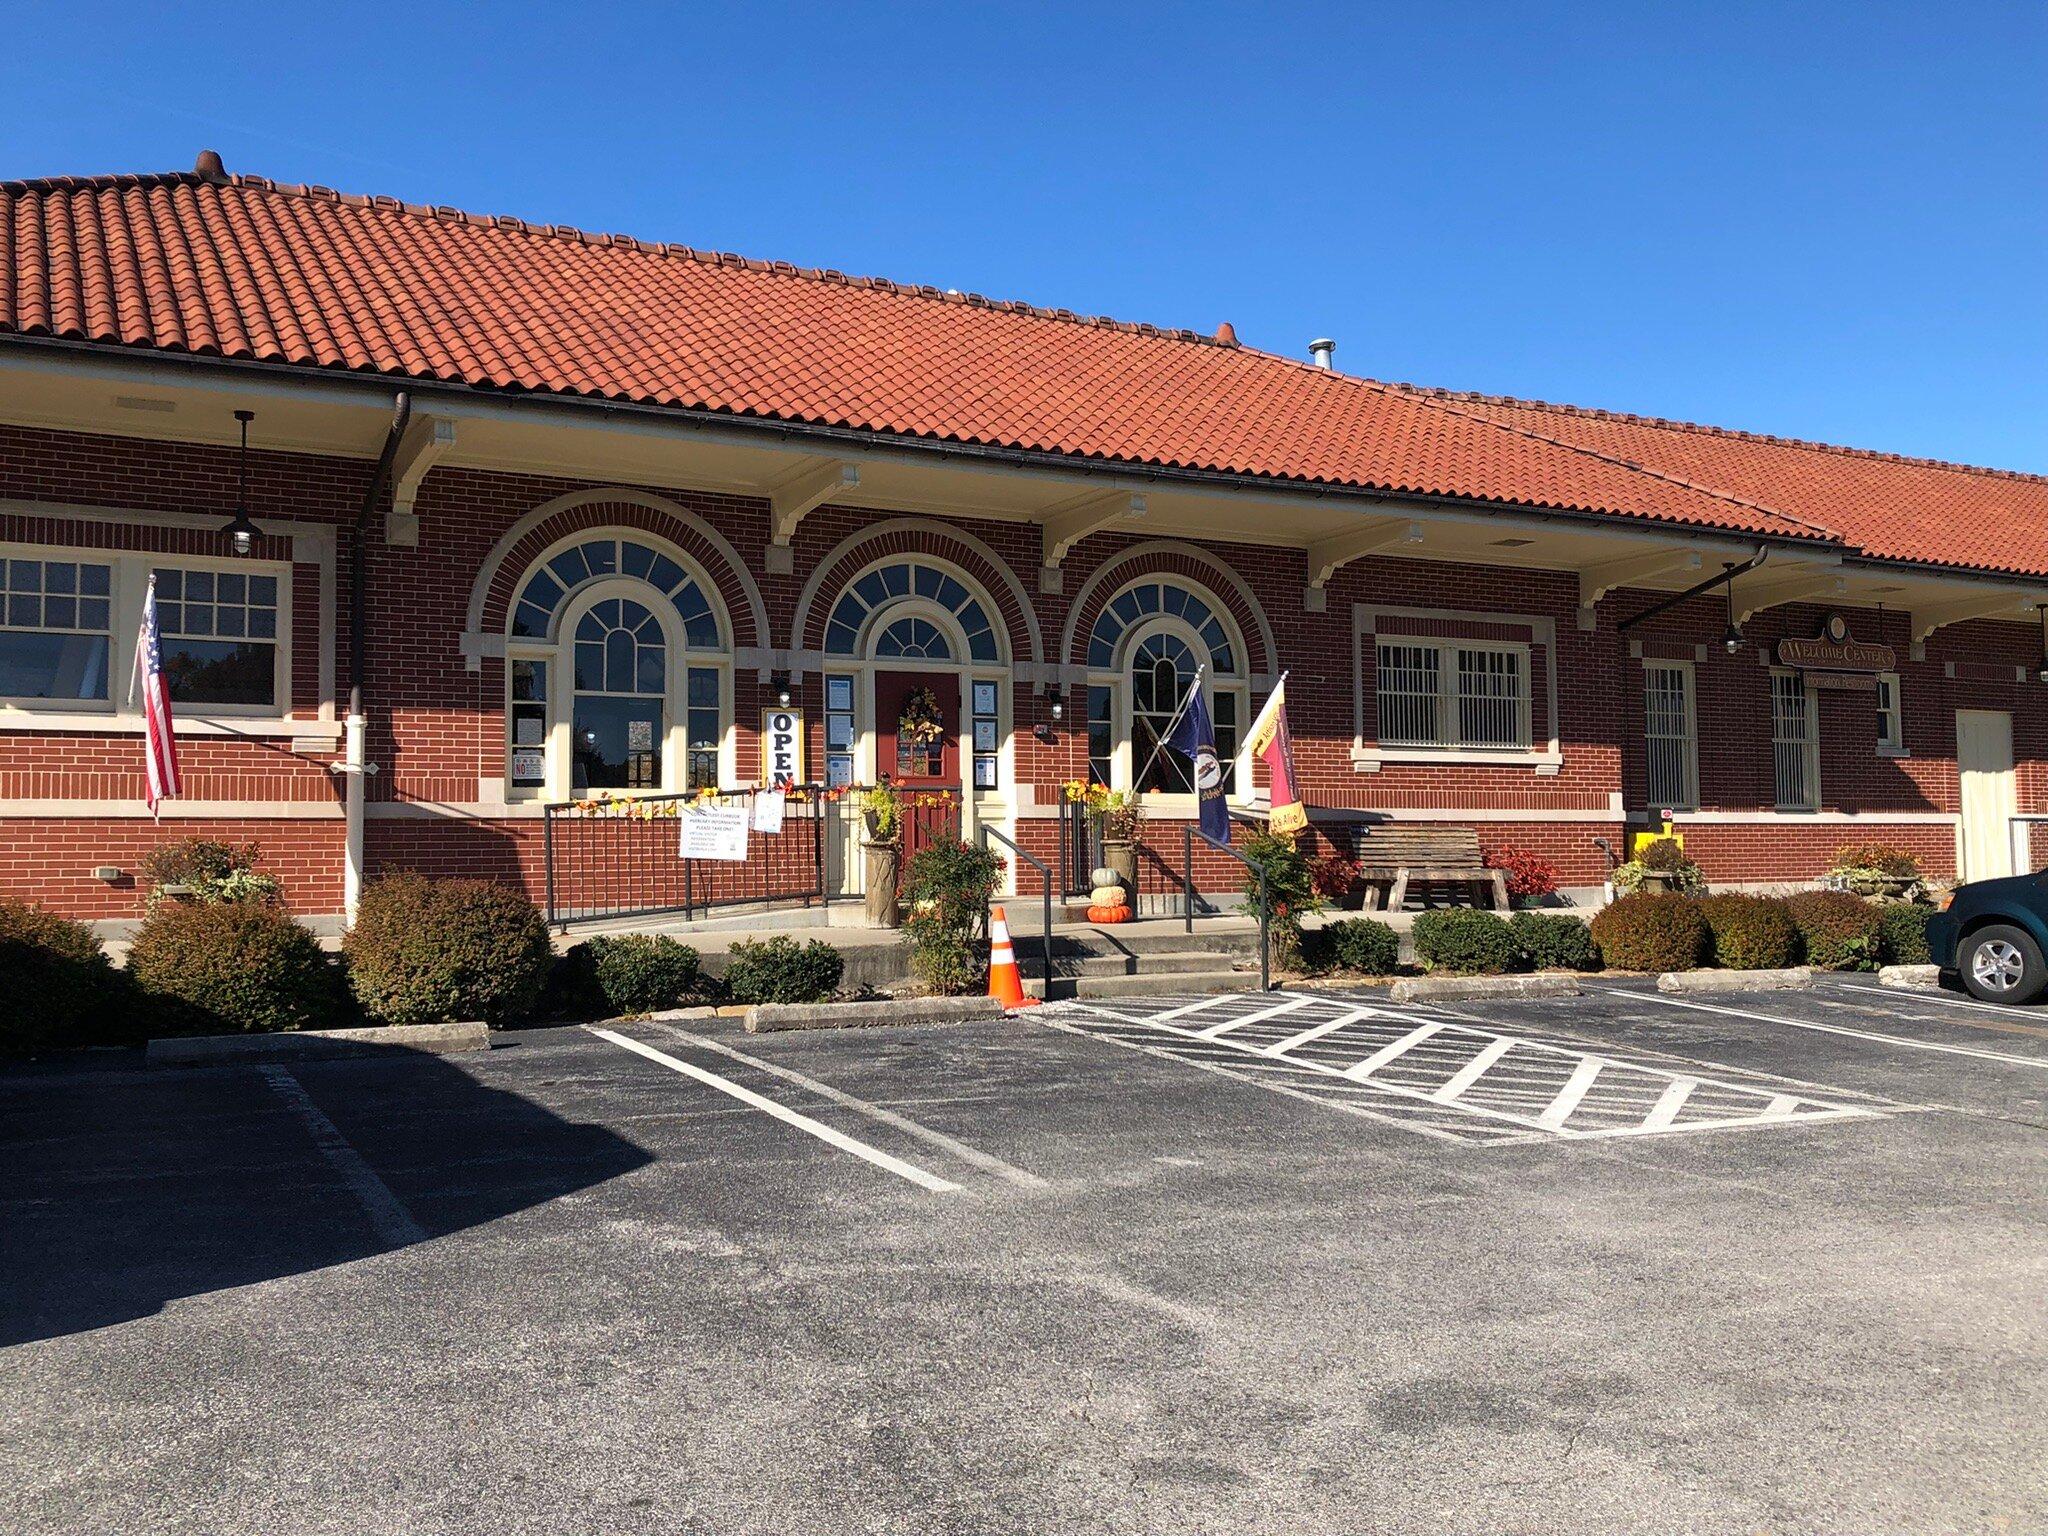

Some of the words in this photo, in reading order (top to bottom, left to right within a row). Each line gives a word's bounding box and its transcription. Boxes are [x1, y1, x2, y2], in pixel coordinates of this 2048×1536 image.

[1788, 642, 1843, 660] WELCOME
[1844, 646, 1887, 665] CENTER
[773, 714, 793, 787] OPEN
[515, 764, 526, 775] NO
